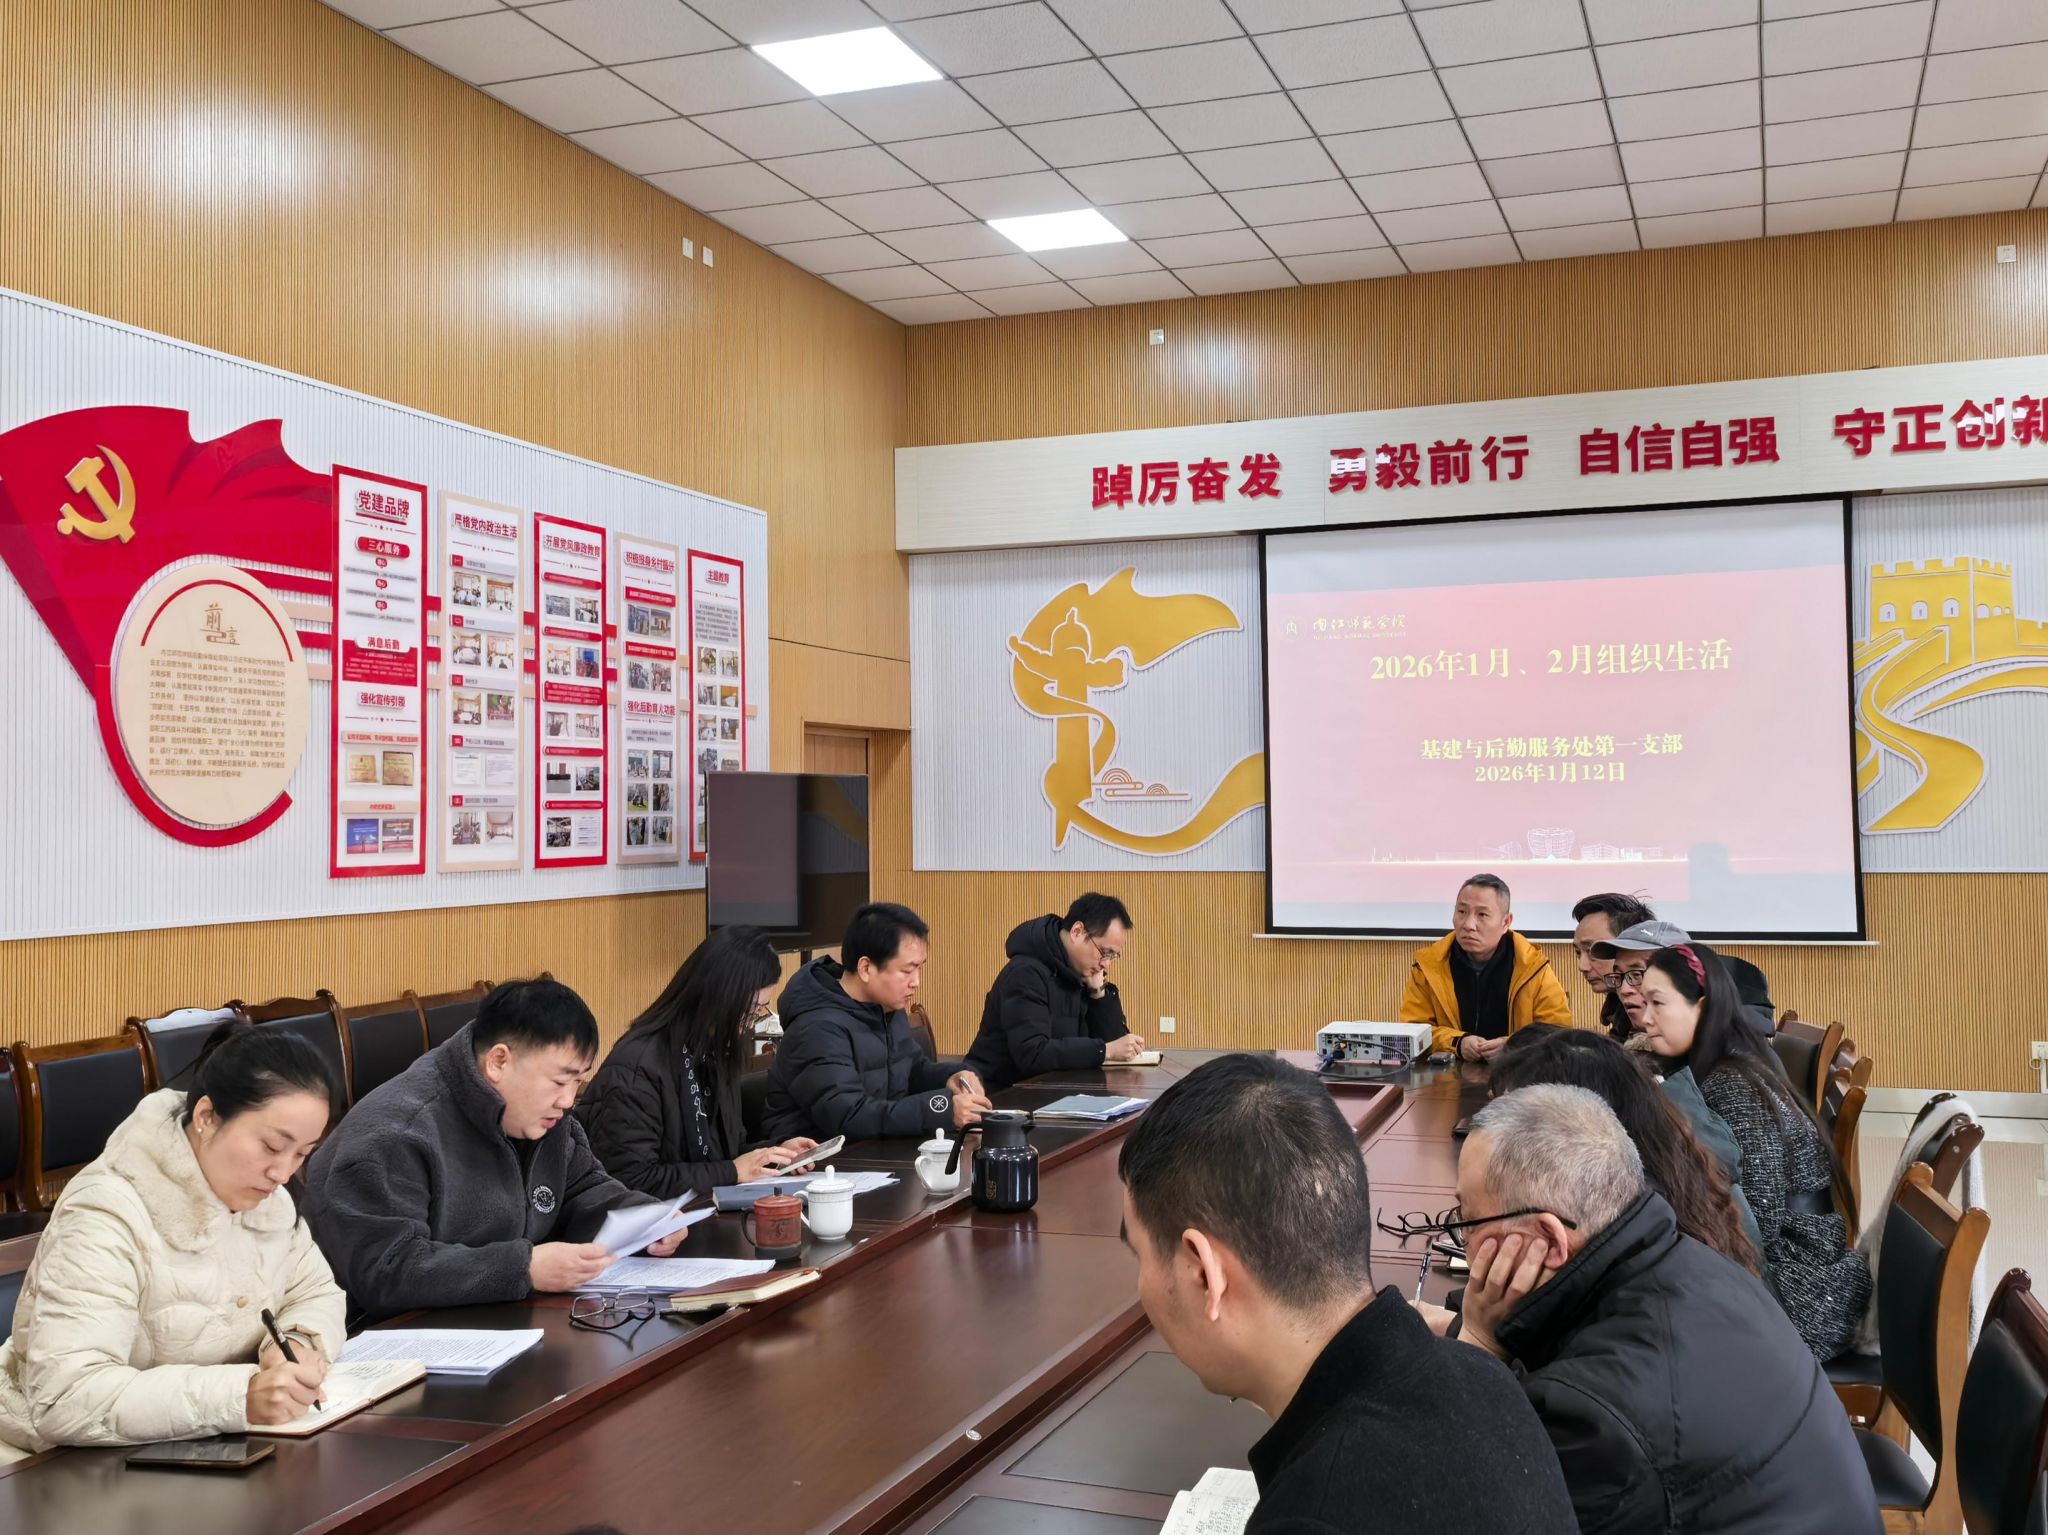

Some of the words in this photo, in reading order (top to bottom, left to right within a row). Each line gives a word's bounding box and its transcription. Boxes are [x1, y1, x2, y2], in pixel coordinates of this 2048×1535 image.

[1092, 453, 1281, 509] 踔厉奋发
[1330, 435, 1529, 493] 勇毅前行
[1581, 417, 1781, 475] 自信自强
[1835, 395, 2048, 456] 守正创新
[358, 489, 410, 518] 党建品牌
[454, 513, 517, 538] 严格党内政治生活
[545, 534, 601, 557] 开展党风廉政教育
[367, 636, 400, 650] 满意后勤
[1370, 638, 1733, 681] 2026年1月、2月组织生活
[1420, 733, 1684, 760] 基建与后勤服务处第一支部
[1474, 762, 1627, 784] 2026年1月12日
